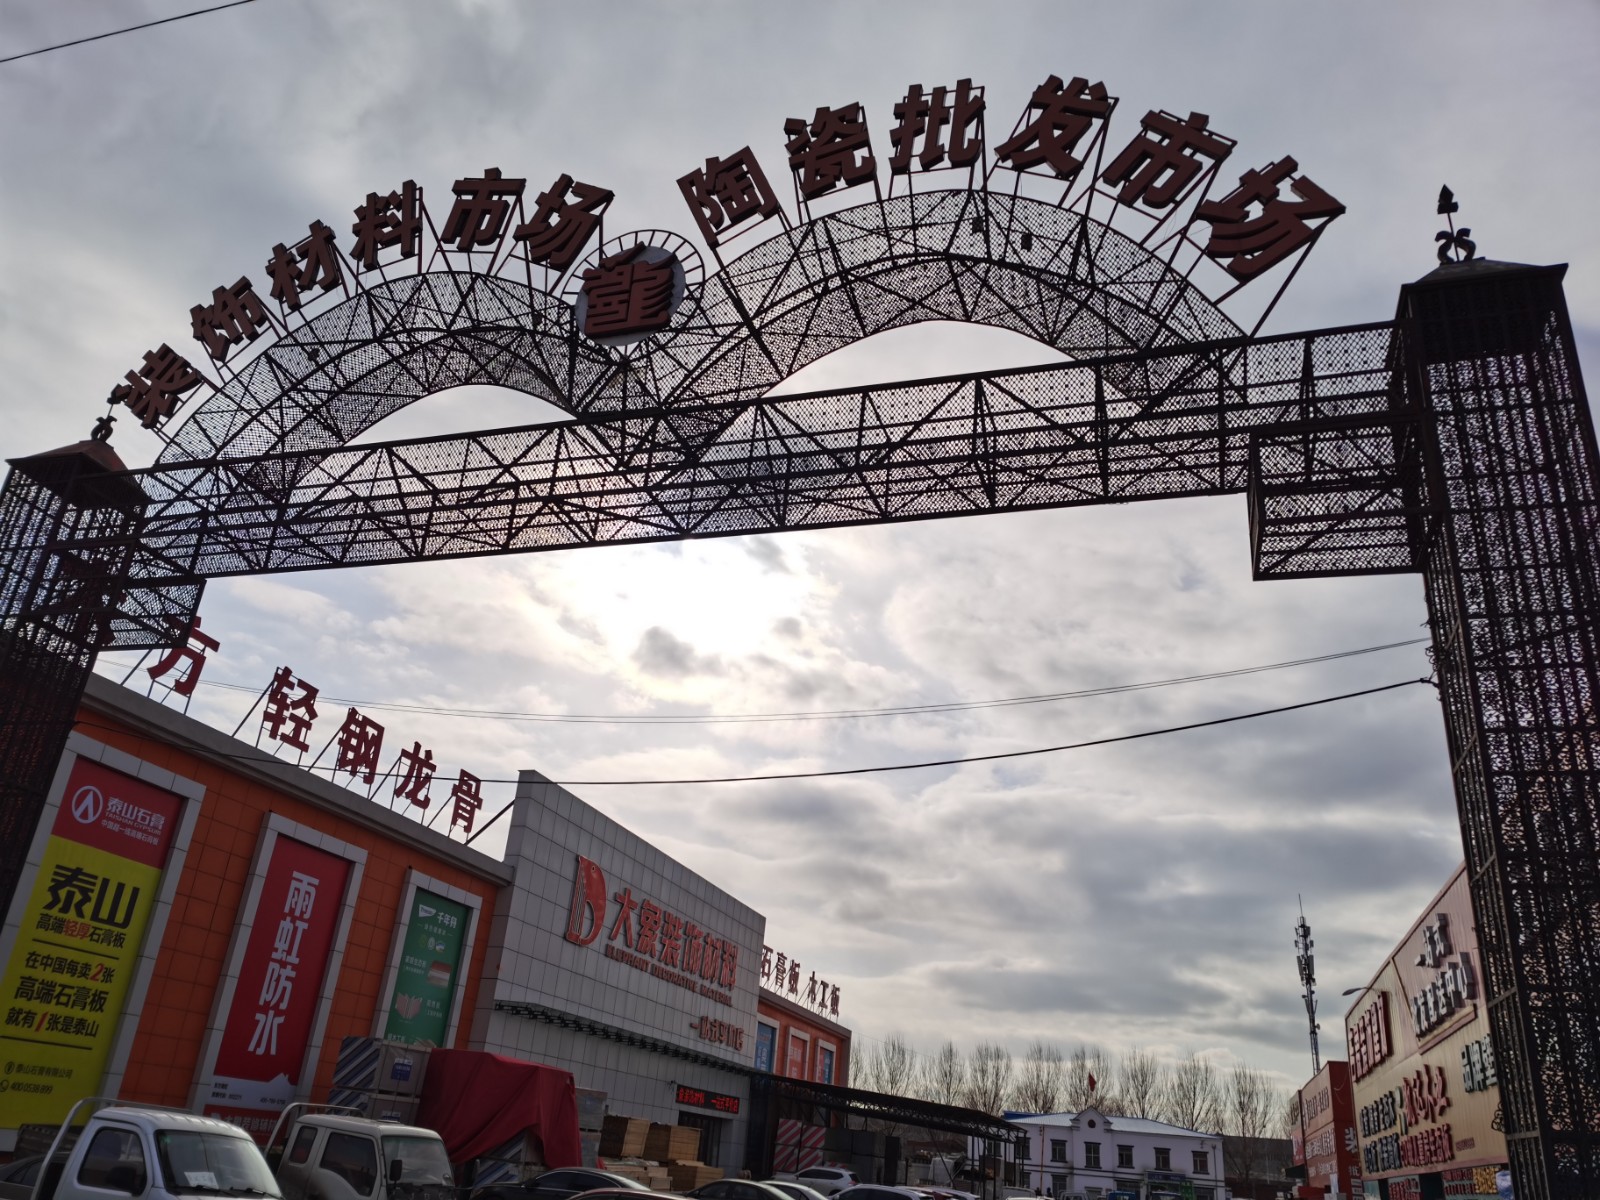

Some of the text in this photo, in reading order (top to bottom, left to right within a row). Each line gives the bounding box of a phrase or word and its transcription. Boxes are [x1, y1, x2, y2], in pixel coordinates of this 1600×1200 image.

[677, 74, 1346, 284] 陶瓷批发市场
[111, 167, 615, 430] 装饰材料市场
[263, 666, 483, 833] 轻钢龙骨
[105, 811, 161, 836] TAISHAN GYPSUM
[106, 797, 165, 830] 泰山石膏
[43, 864, 140, 929] 泰山
[36, 913, 126, 948] 高端轻厚石膏板
[609, 887, 738, 991] 大象装饰材料
[1414, 912, 1453, 969] 一站式
[24, 951, 116, 984] 在中国每卖2张
[248, 871, 319, 1055] 雨虹防水
[605, 944, 733, 1008] ELEPHANT DECORATIVE MATERIAL
[5, 1006, 100, 1038] 就有1张是泰山
[14, 976, 110, 1013] 高端石膏板
